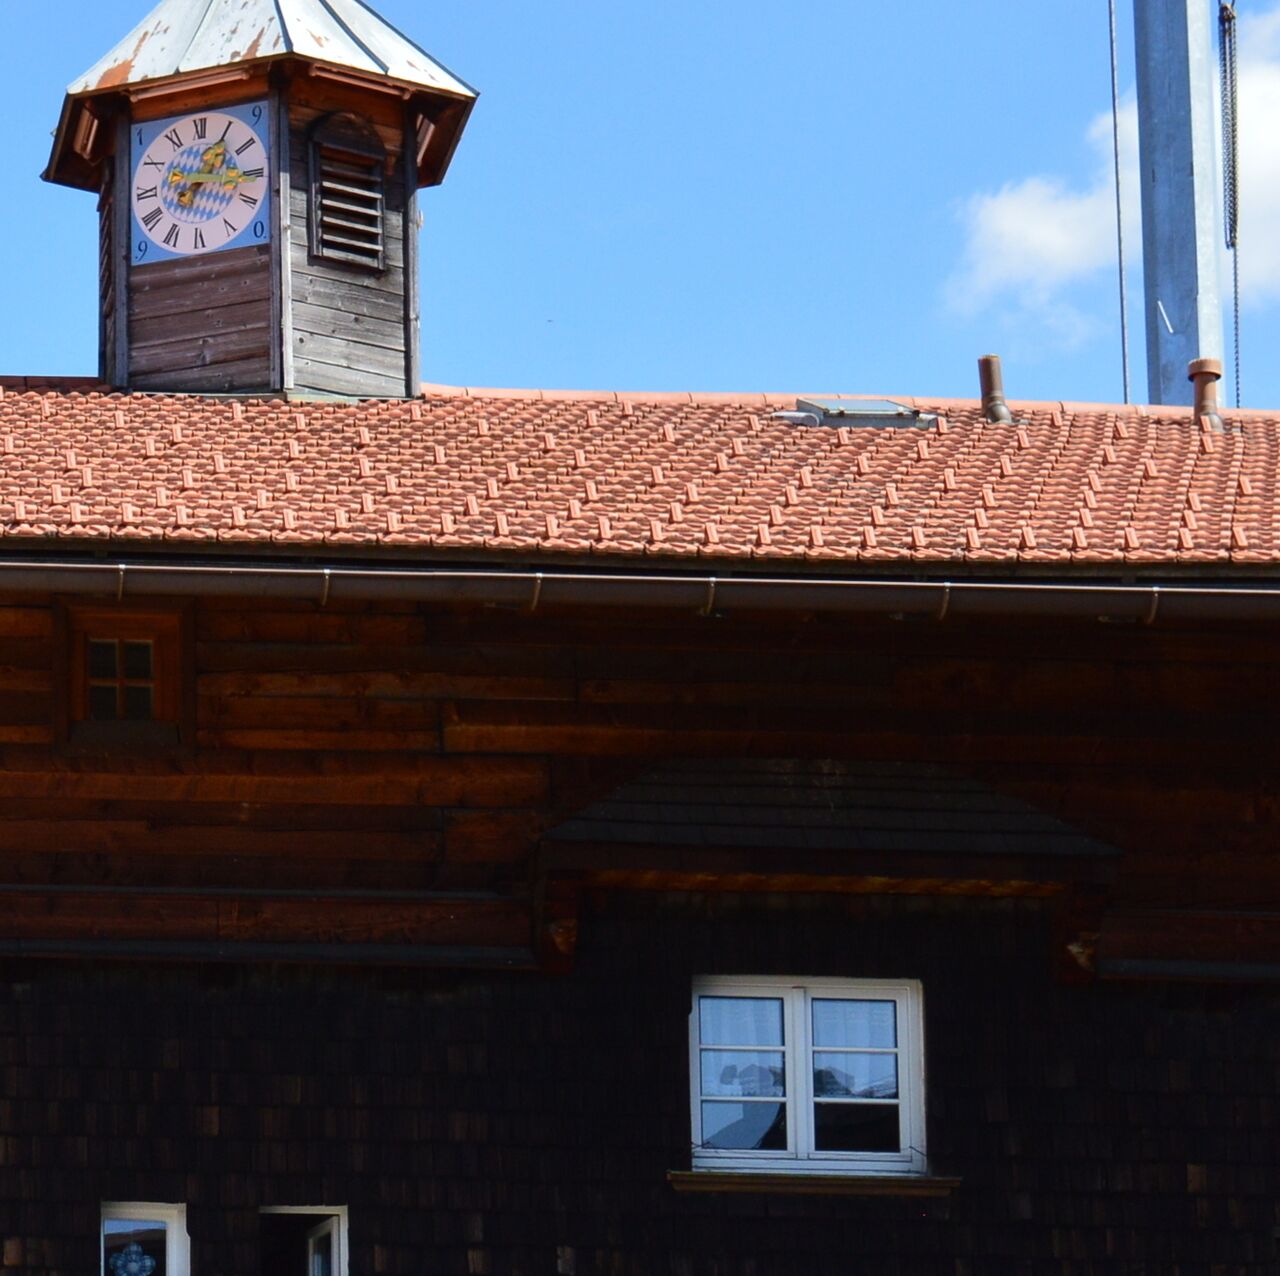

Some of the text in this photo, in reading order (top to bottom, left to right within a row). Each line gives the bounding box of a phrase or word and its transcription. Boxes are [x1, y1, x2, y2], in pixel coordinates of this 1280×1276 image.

[164, 128, 184, 152] XI
[192, 117, 207, 141] XII
[235, 137, 256, 156] II
[143, 155, 165, 172] X
[137, 186, 157, 202] IX
[141, 206, 163, 232] VIII
[223, 218, 238, 237] V
[162, 223, 180, 248] VII
[194, 227, 206, 249] VI
